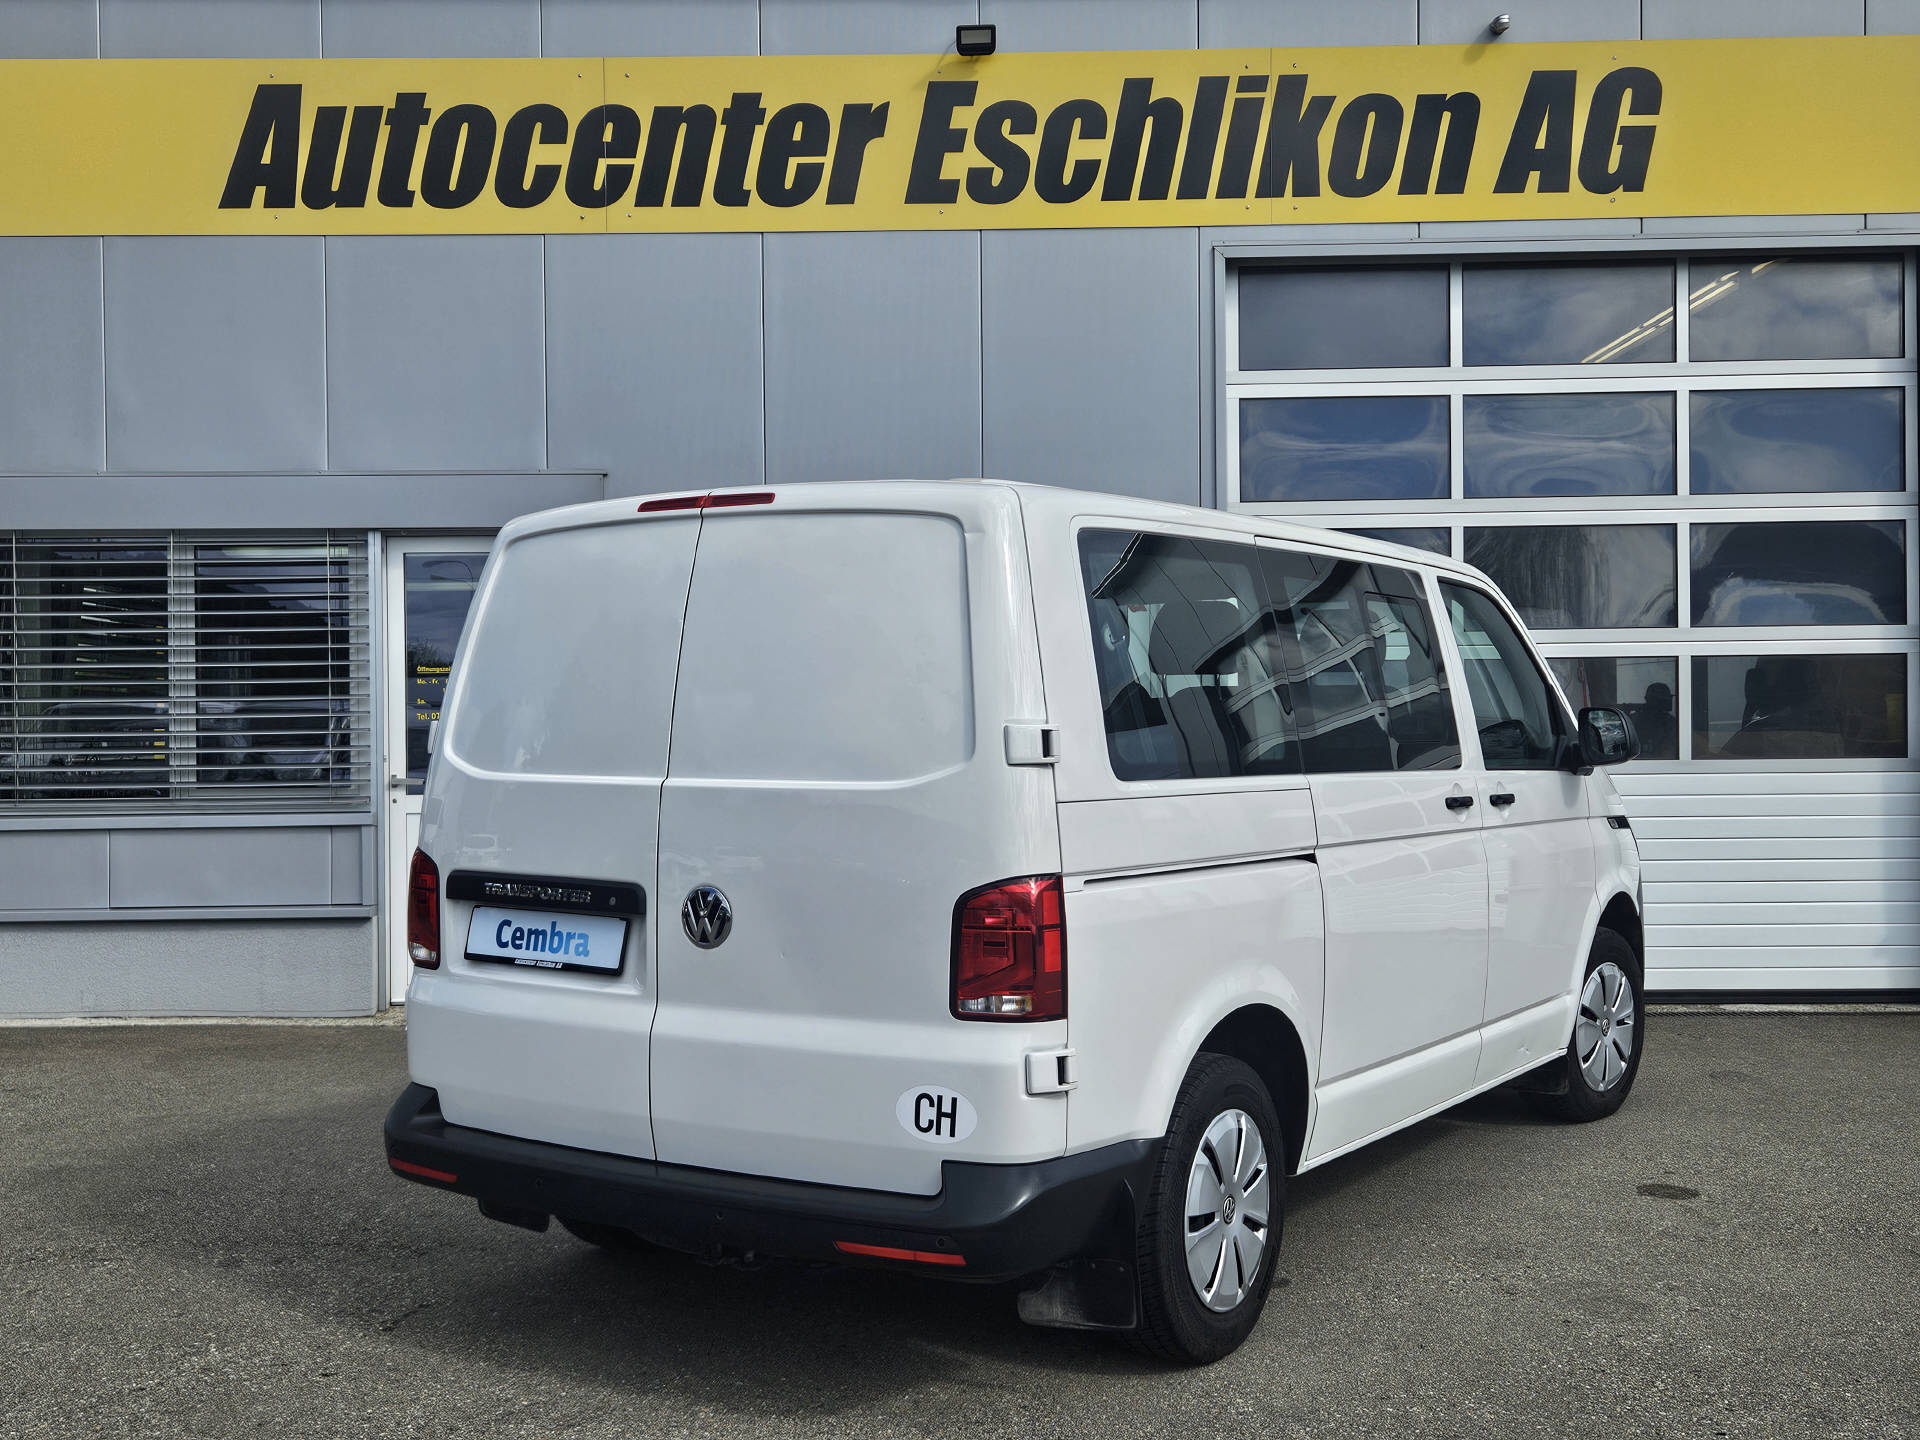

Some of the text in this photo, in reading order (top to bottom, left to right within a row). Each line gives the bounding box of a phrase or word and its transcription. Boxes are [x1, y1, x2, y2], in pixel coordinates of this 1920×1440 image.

[218, 66, 1663, 209] Autocenter Eschlikon AG
[416, 712, 430, 720] Tel.
[484, 882, 592, 903] TRANSPORTER
[495, 918, 590, 958] Cembra
[914, 1092, 958, 1138] CH
